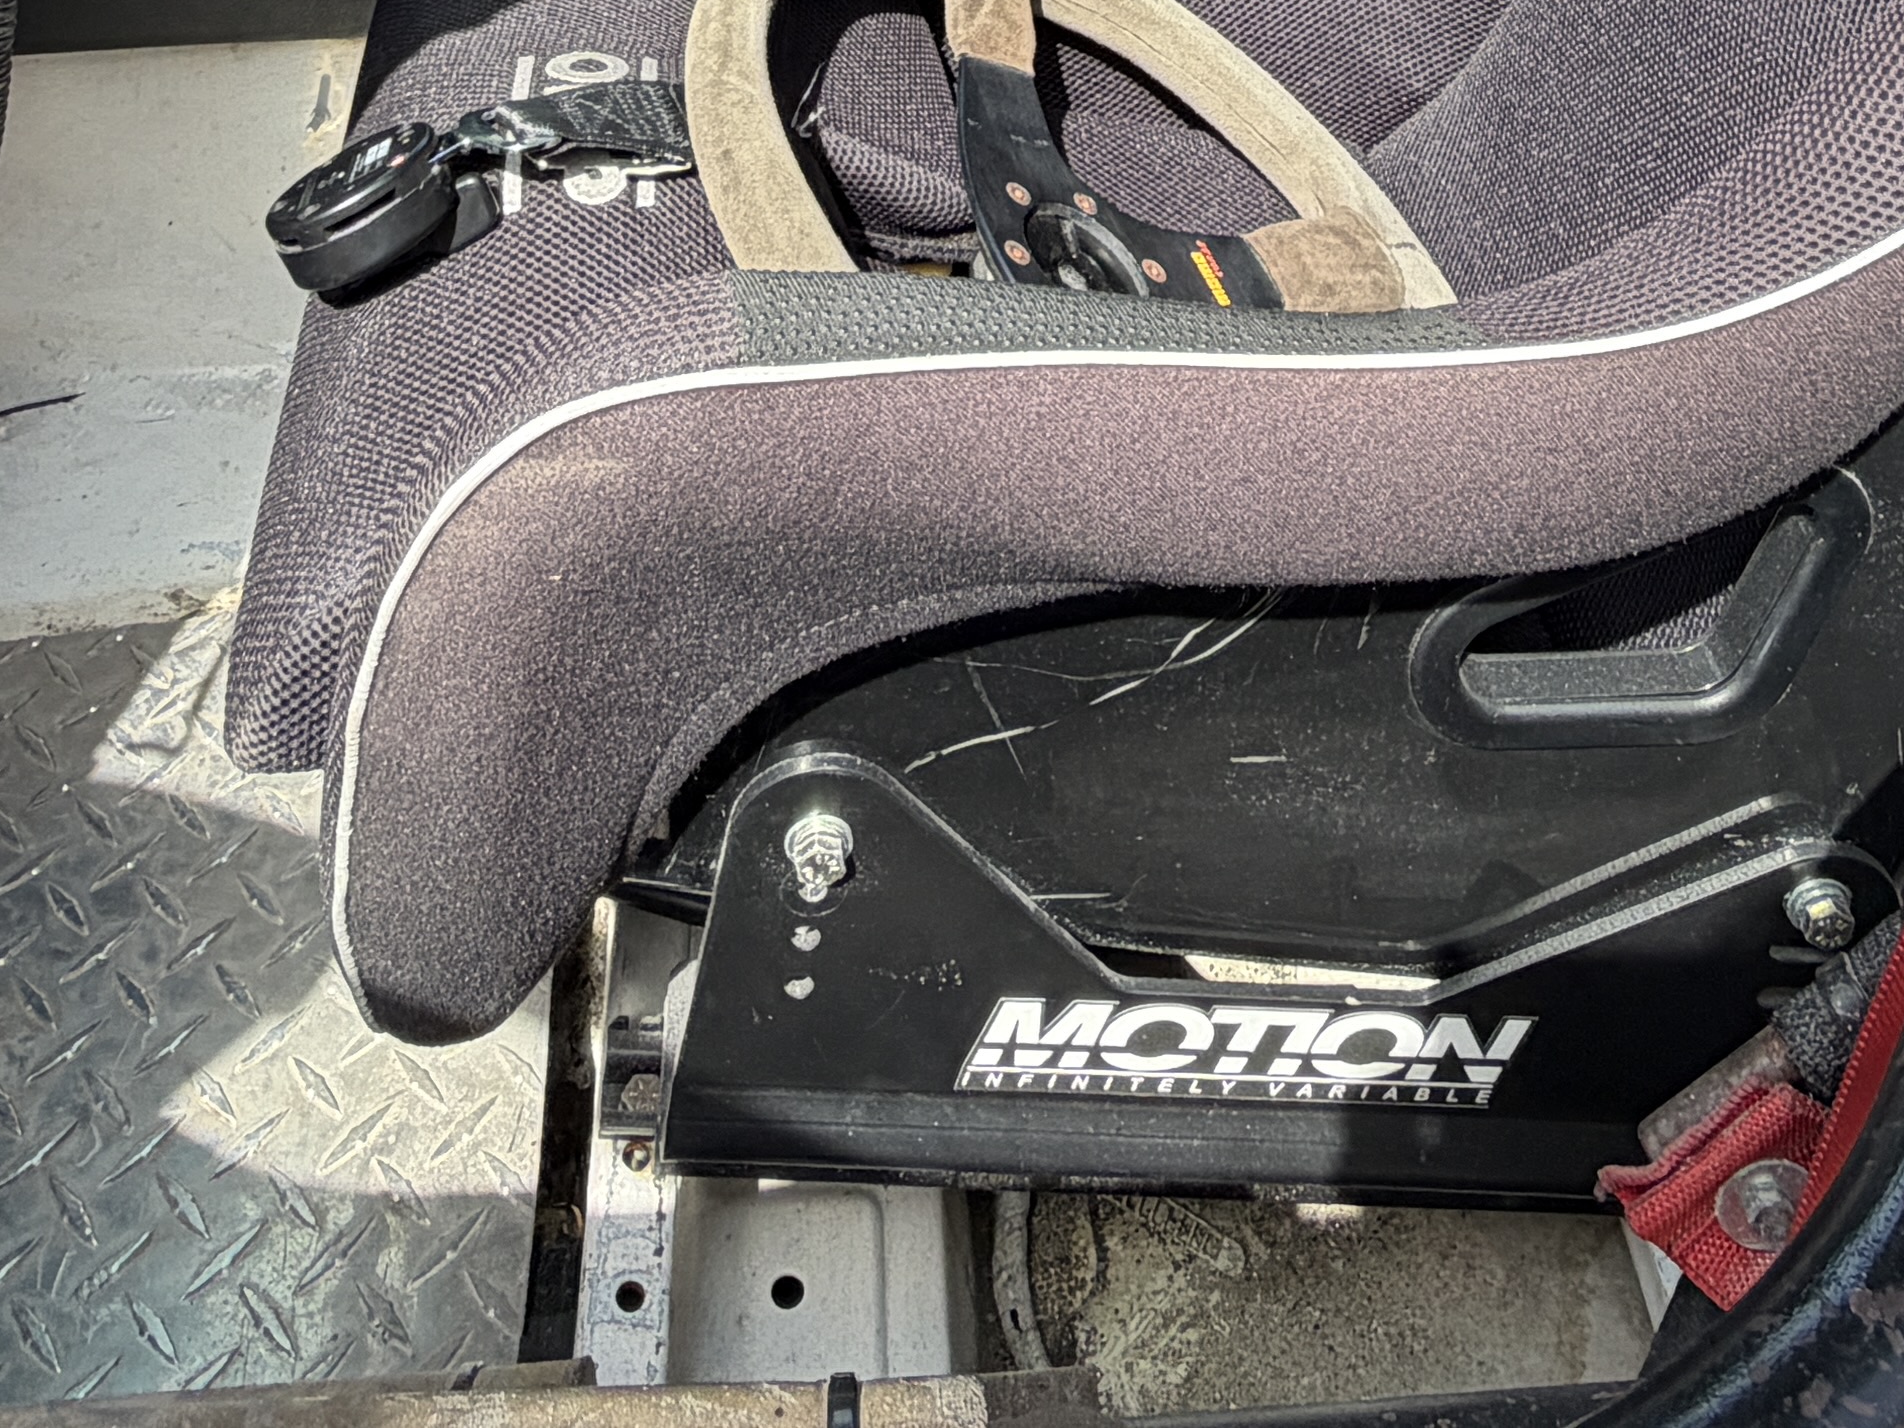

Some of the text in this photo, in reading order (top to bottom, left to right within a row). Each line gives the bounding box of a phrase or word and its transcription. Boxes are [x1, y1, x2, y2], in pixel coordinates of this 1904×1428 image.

[971, 997, 1538, 1082] MOTION
[960, 1071, 1494, 1105] INFINITELY VARIABLE
